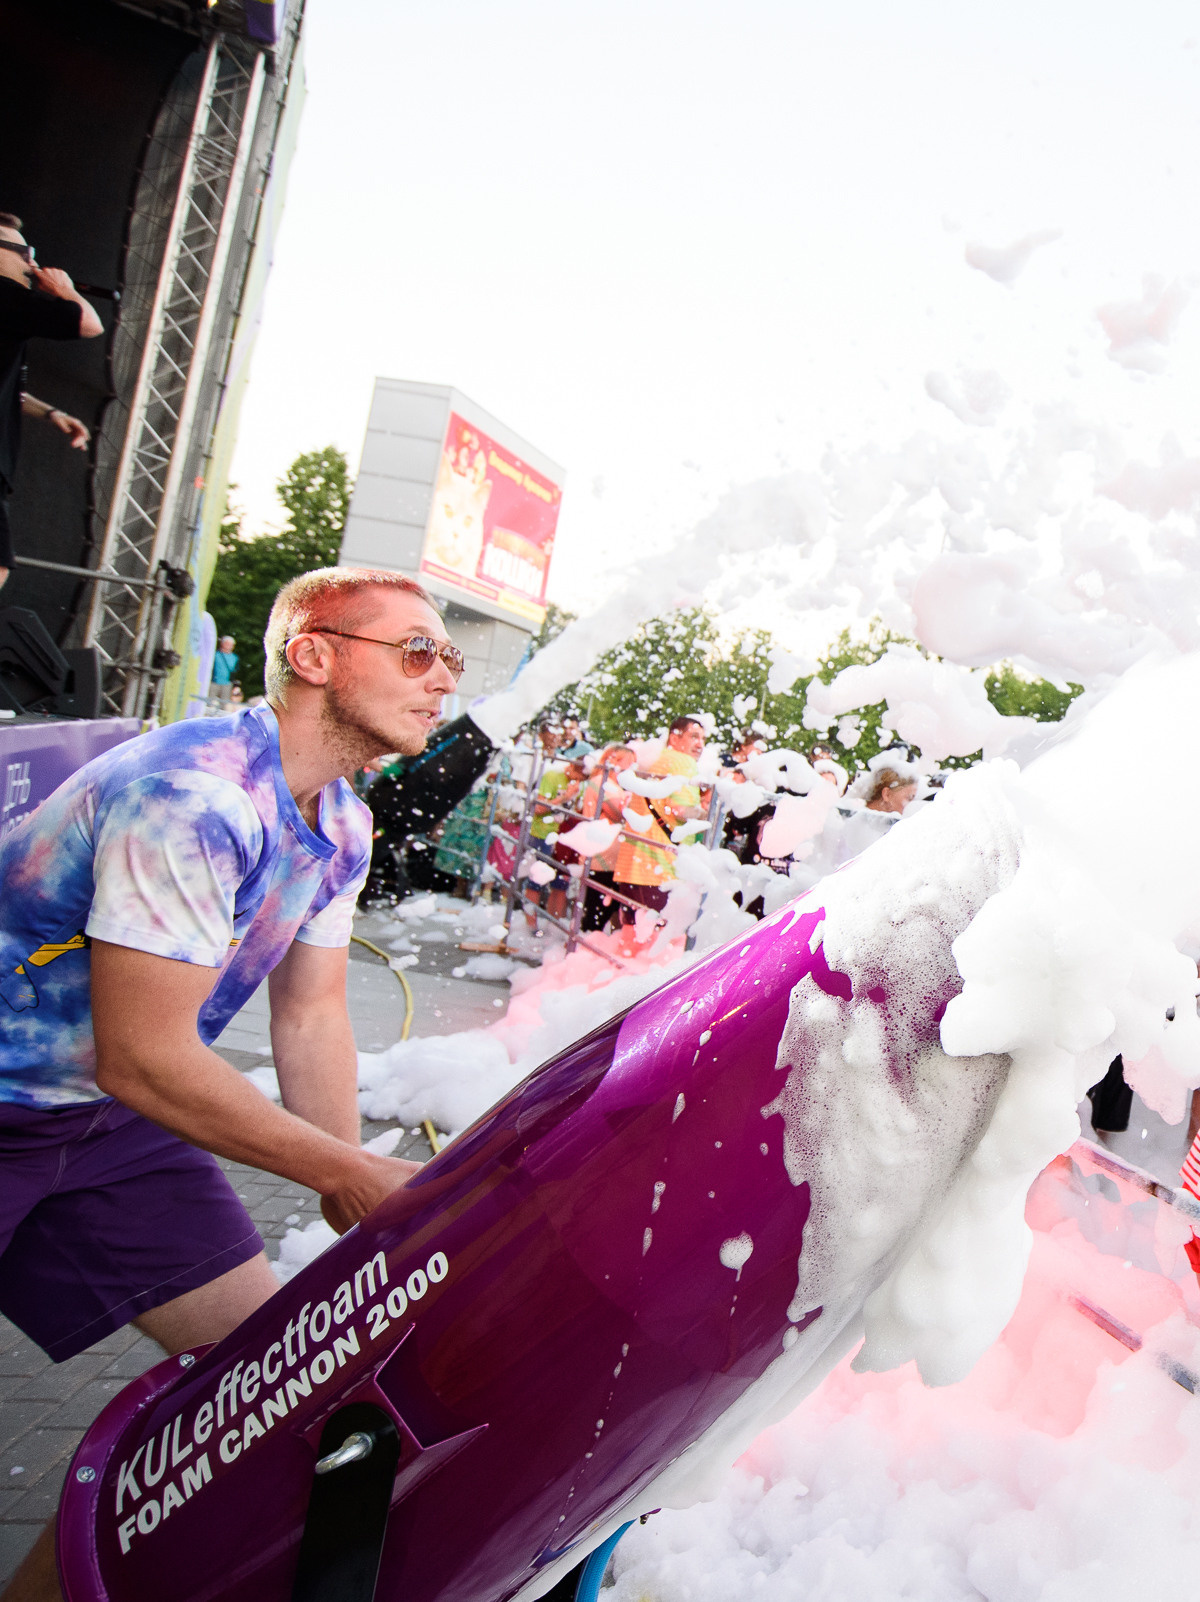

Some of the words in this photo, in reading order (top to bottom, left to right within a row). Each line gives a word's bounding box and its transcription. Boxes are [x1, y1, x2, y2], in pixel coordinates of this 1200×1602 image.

[116, 1251, 389, 1515] KULeffectfoam
[117, 1453, 213, 1554] FOAM
[219, 1326, 361, 1464] CANNON
[366, 1251, 449, 1341] 2000
